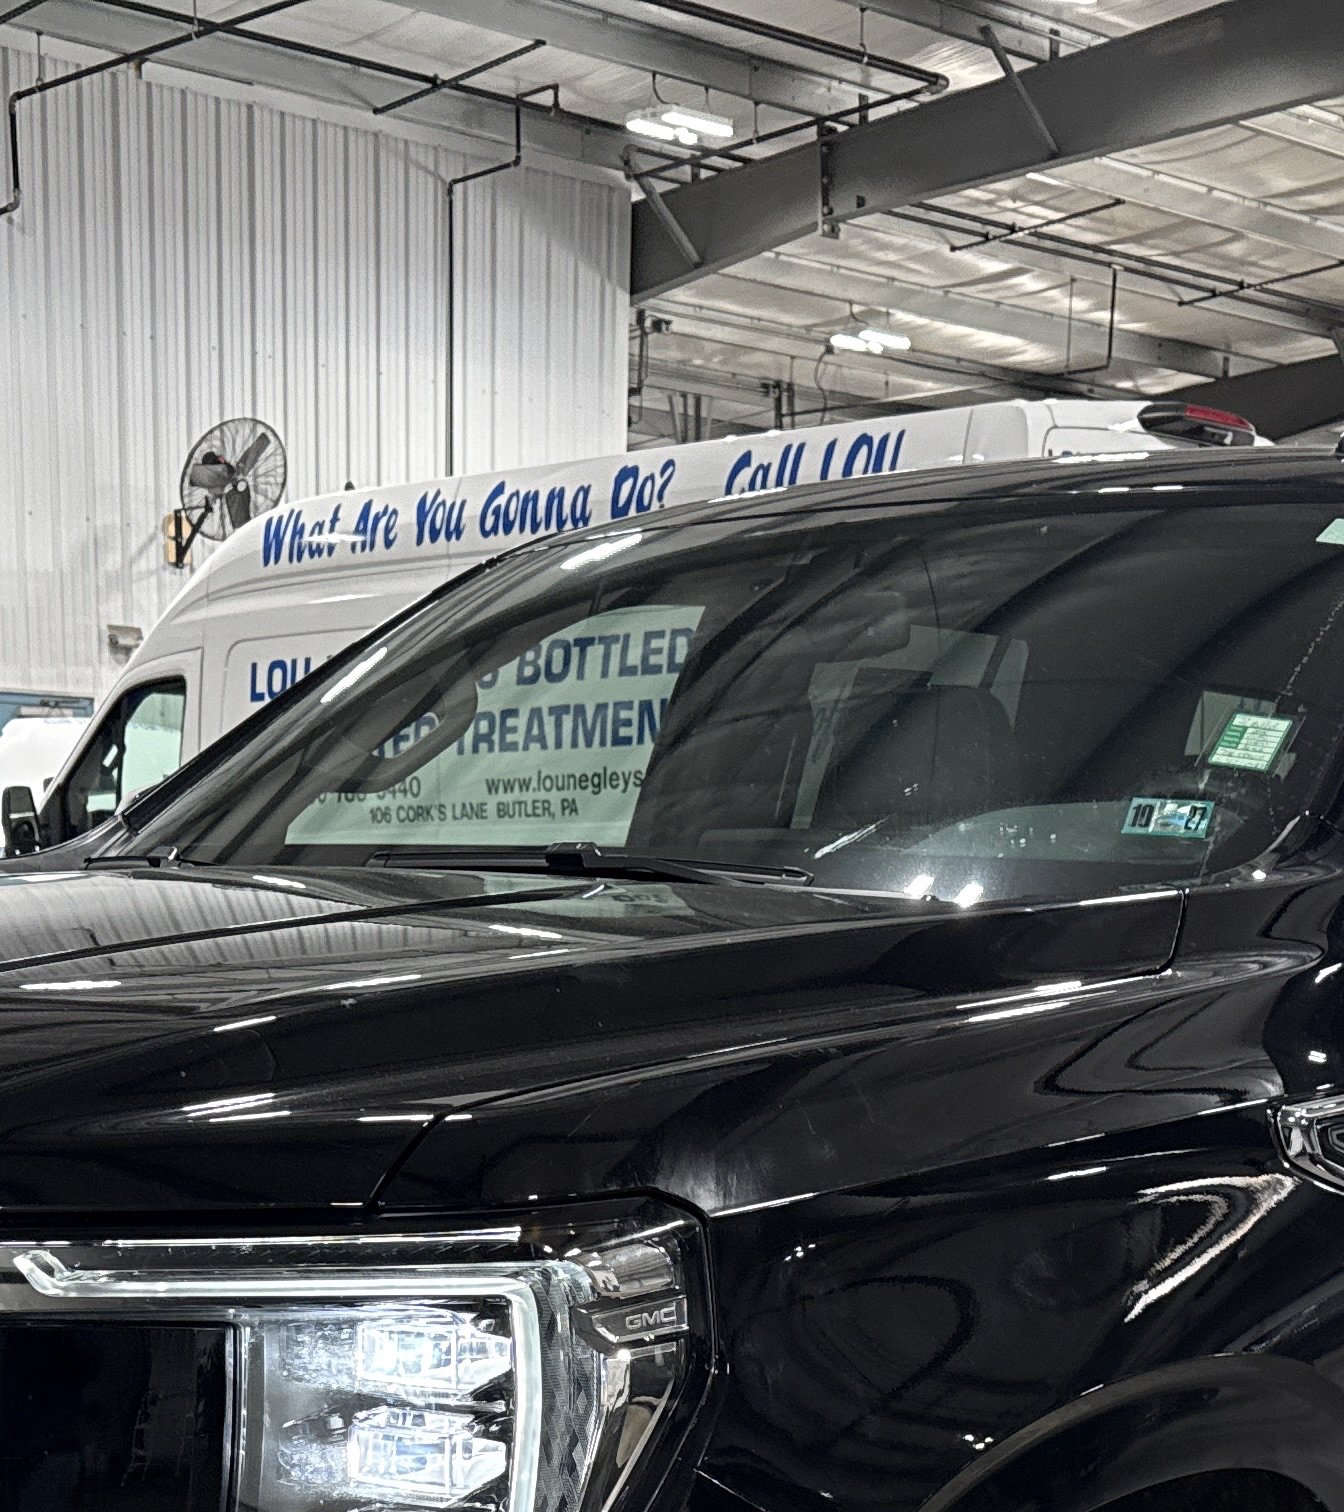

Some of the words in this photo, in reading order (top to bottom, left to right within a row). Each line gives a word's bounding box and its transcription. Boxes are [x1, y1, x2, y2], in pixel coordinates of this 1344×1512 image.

[262, 503, 343, 568] What
[351, 499, 399, 553] Are
[415, 489, 467, 546] You
[479, 480, 592, 539] Gonna
[610, 458, 676, 520] Do?
[724, 441, 806, 496] Call
[516, 627, 697, 687] BOTTLED
[457, 697, 669, 756] REATMEN
[369, 806, 392, 824] 106
[396, 802, 447, 823] CORK'S
[452, 802, 488, 821] LANE
[496, 800, 555, 820] BUTLER,
[561, 798, 579, 817] PA
[625, 1306, 677, 1330] GMC
